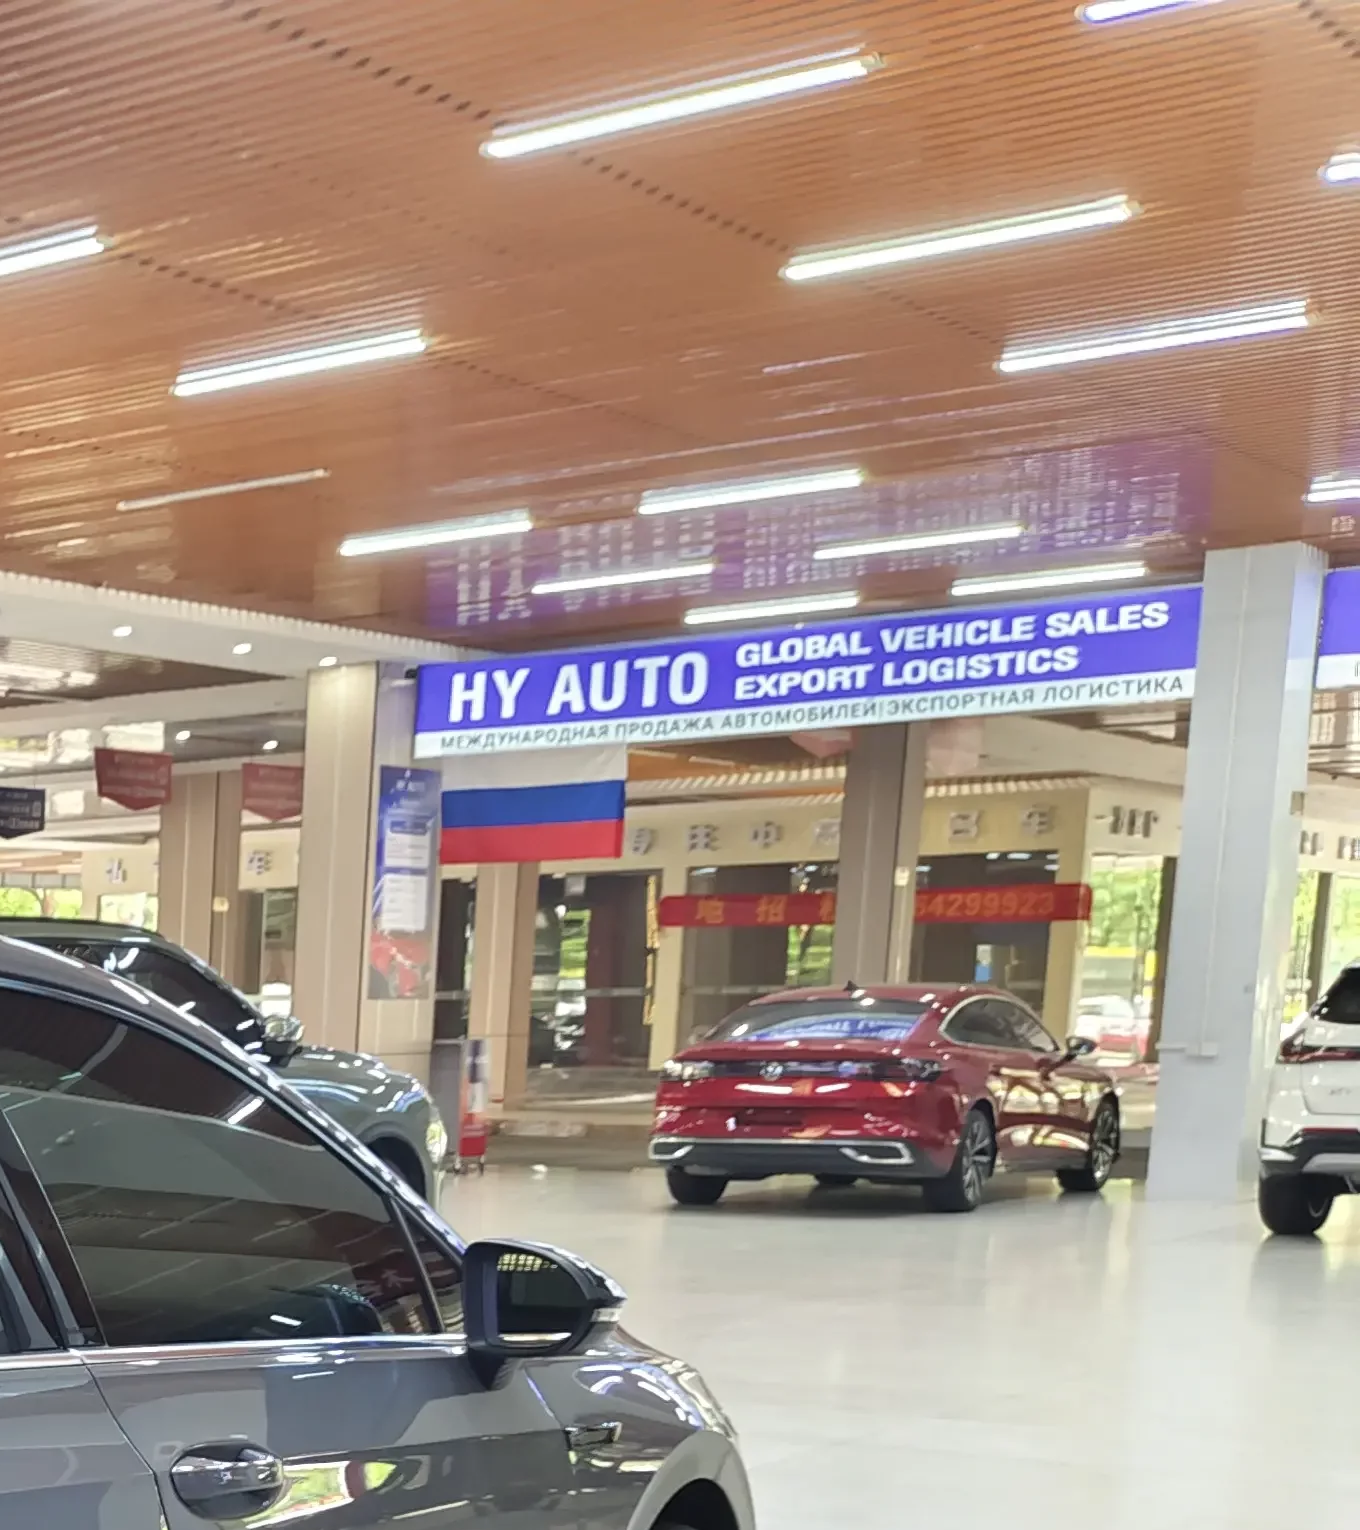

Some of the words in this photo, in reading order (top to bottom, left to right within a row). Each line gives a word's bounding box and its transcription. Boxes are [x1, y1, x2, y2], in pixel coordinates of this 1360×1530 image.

[735, 630, 872, 668] GLOBAL
[880, 615, 1037, 653] VEHICLE
[1045, 602, 1169, 639] SALES
[448, 668, 530, 723] HY
[546, 651, 708, 716] AUTO
[734, 663, 875, 701] EXPORT
[882, 646, 1081, 687] LOGISTICS
[441, 724, 609, 750] МЕЖДУНАРОДНАЯ
[615, 716, 713, 739] ПРОДАЖА
[1043, 675, 1183, 703] ЛОГИСТИКА
